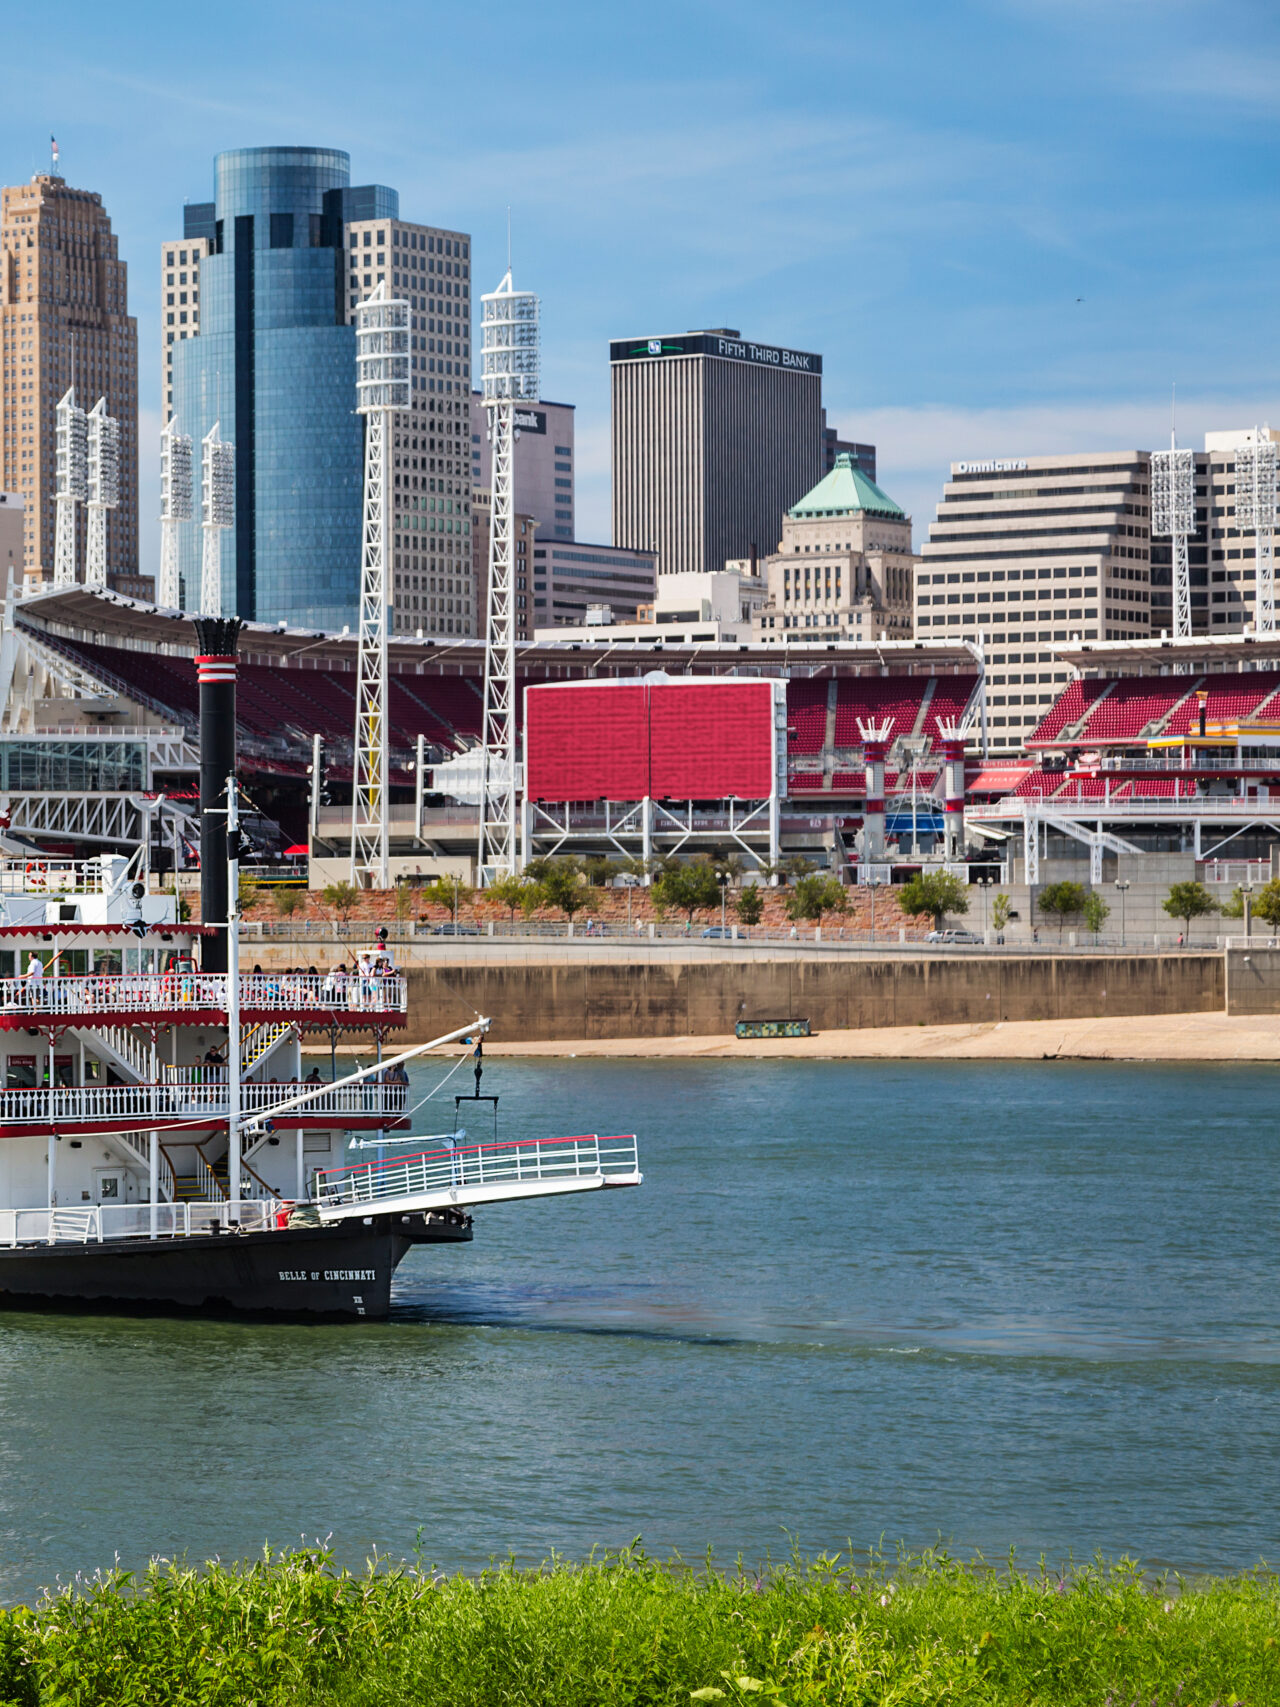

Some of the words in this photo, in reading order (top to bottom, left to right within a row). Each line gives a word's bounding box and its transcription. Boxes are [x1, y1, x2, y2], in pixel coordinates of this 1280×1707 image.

[718, 339, 746, 358] FIFTH
[749, 344, 780, 364] THIRD
[783, 351, 810, 370] BANK
[958, 459, 1028, 473] Omnicare
[278, 1271, 307, 1281] BELLE
[311, 1271, 320, 1281] OF
[324, 1269, 376, 1281] CINCINNATI
